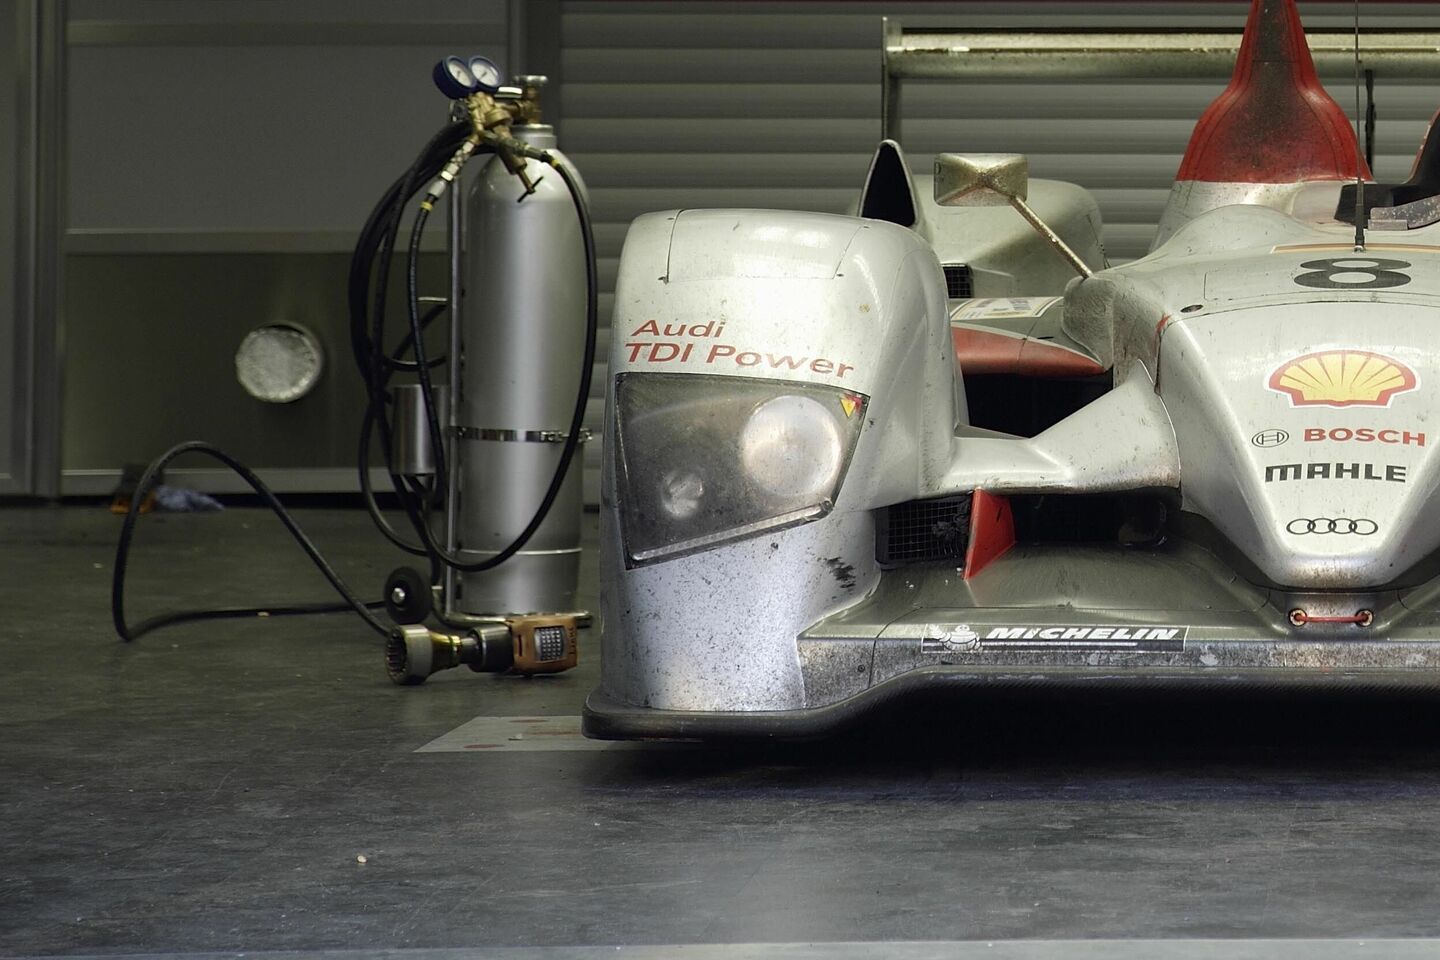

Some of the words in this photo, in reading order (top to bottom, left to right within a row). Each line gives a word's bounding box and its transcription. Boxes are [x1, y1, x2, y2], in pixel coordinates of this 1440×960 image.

[1294, 257, 1411, 289] 8
[631, 318, 727, 339] Audi
[625, 342, 695, 363] TDI
[706, 343, 855, 380] Power
[1303, 427, 1425, 447] BOSCH
[1265, 462, 1407, 483] MAHLE
[986, 627, 1179, 641] MICHELIN
